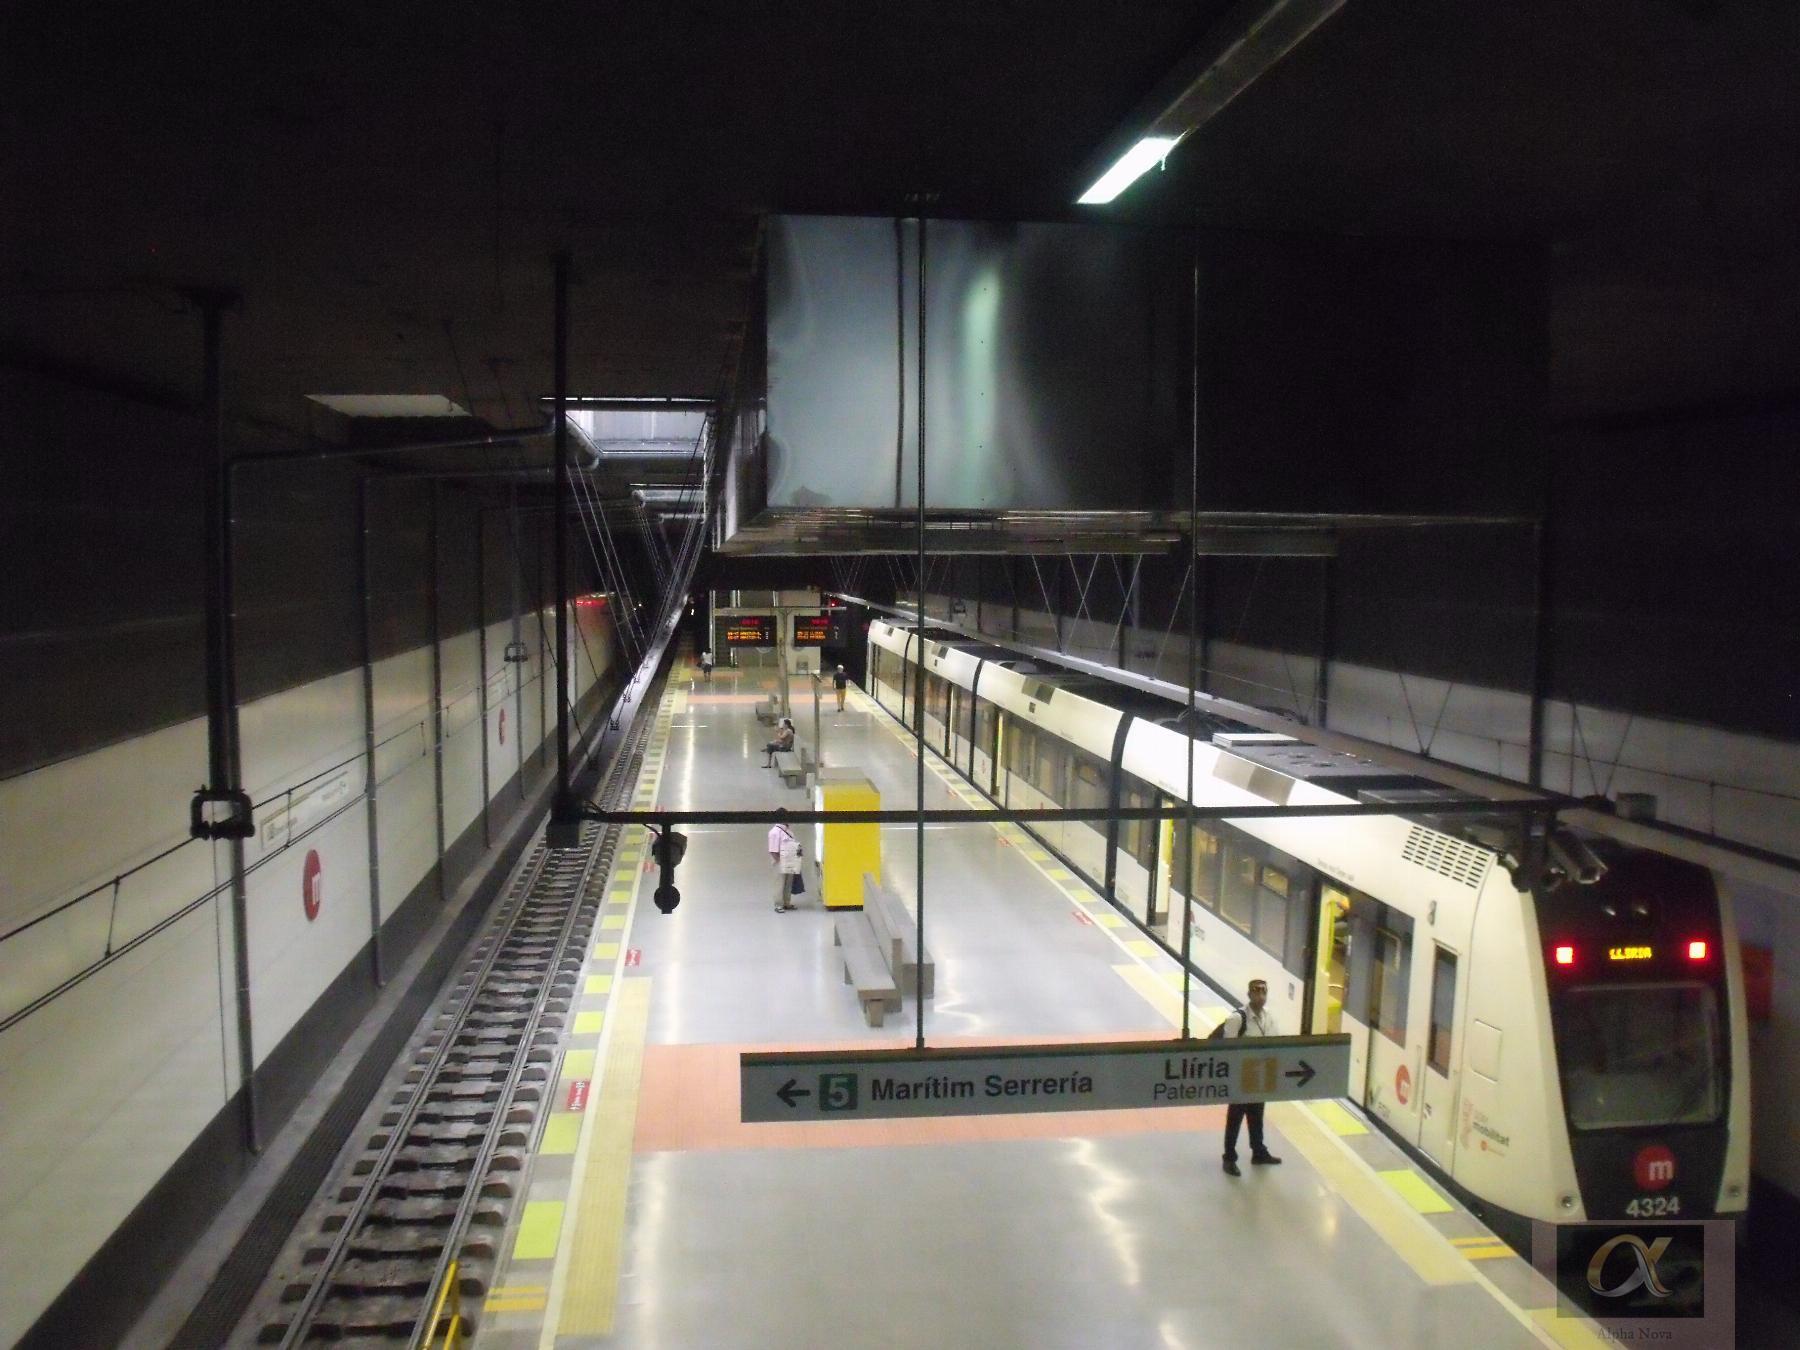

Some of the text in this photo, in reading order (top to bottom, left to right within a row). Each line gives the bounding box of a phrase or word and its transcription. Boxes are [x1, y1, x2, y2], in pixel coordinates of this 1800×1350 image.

[1164, 1056, 1230, 1081] Llíria
[827, 1070, 1093, 1108] 5 Marítim Serrería
[1153, 1082, 1230, 1101] Paterna
[1648, 1160, 1674, 1181] m
[1625, 1196, 1681, 1218] 4324
